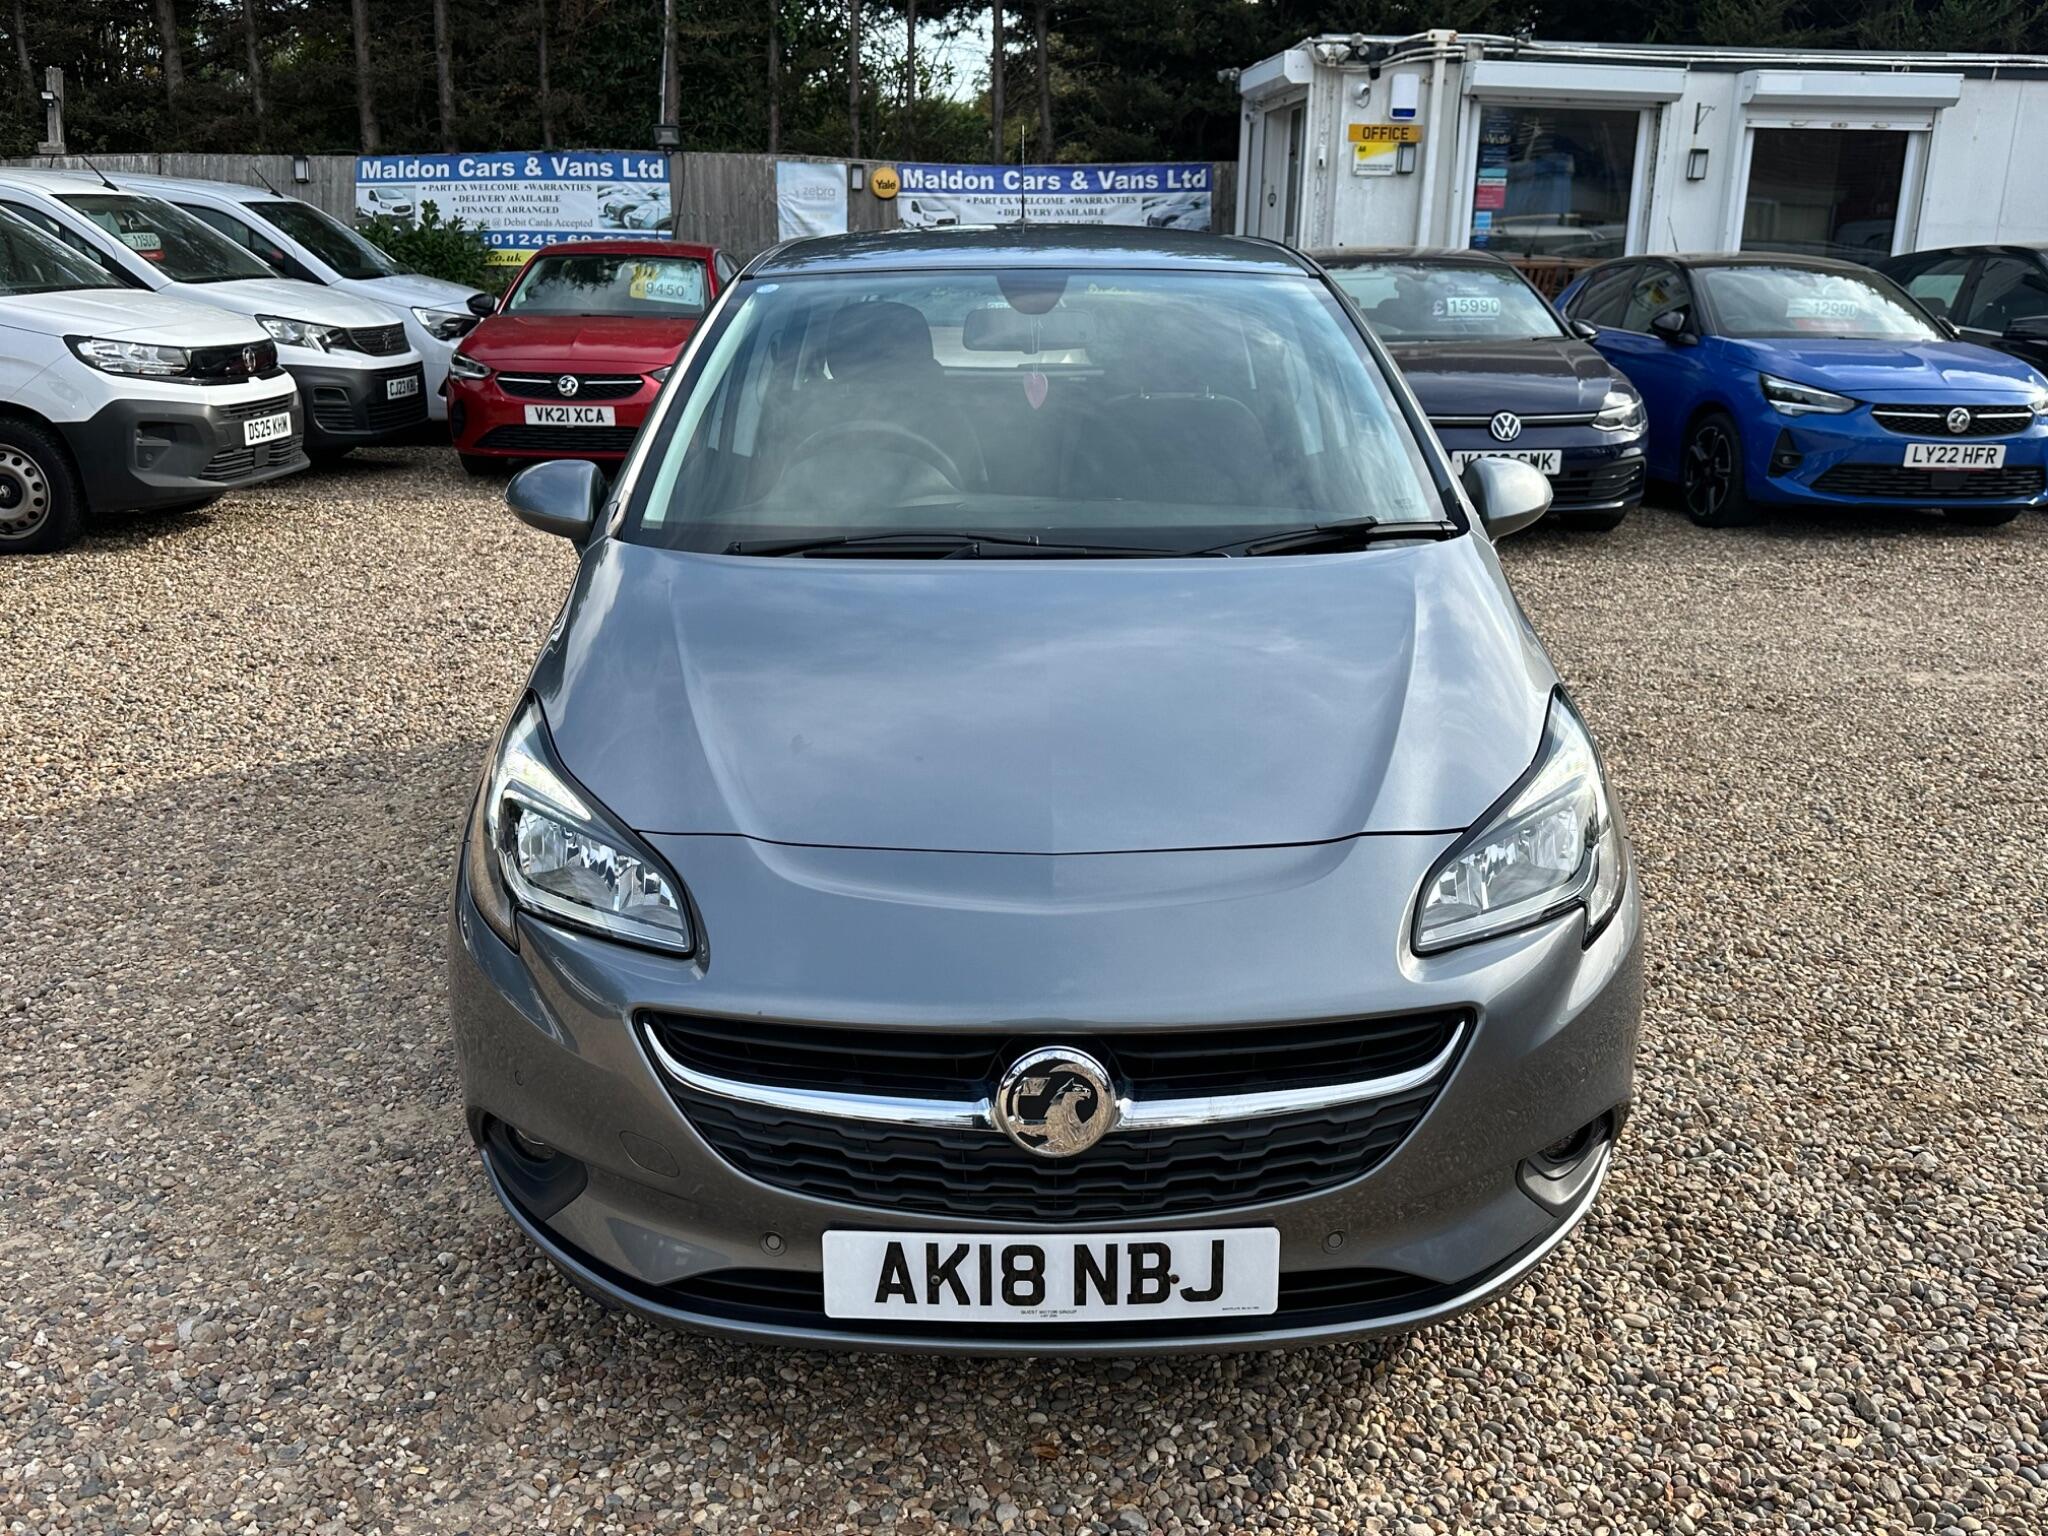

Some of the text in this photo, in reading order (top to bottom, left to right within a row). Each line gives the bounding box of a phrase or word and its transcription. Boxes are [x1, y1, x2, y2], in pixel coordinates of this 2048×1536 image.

[1362, 126, 1409, 140] OFFICE
[362, 157, 664, 179] Maldon Cars & Vans Ltd
[876, 180, 896, 190] Yale
[902, 168, 1207, 190] Maldon Cars & Vans Ltd
[470, 183, 520, 191] WELCOME
[528, 184, 592, 192] WARRANTIES
[802, 186, 836, 197] zebra
[509, 194, 561, 202] AVAILABLE
[1000, 197, 1013, 205] EX
[1015, 197, 1066, 205] WELCOME
[1073, 196, 1137, 204] WARRANTIES
[505, 206, 559, 214] ARRANGED
[1003, 208, 1106, 216] DELVERY AVAILABLE
[504, 218, 527, 226] Debit
[528, 218, 552, 227] Cards
[554, 218, 593, 229] Accepted
[646, 281, 685, 298] 9450
[1450, 299, 1499, 314] 15990
[1814, 302, 1857, 317] 12990
[535, 406, 605, 423] VK21 XCA
[248, 418, 272, 441] DS25
[1912, 446, 1998, 464] LY22 HFR
[874, 1239, 1225, 1307] AK18 NBJ
